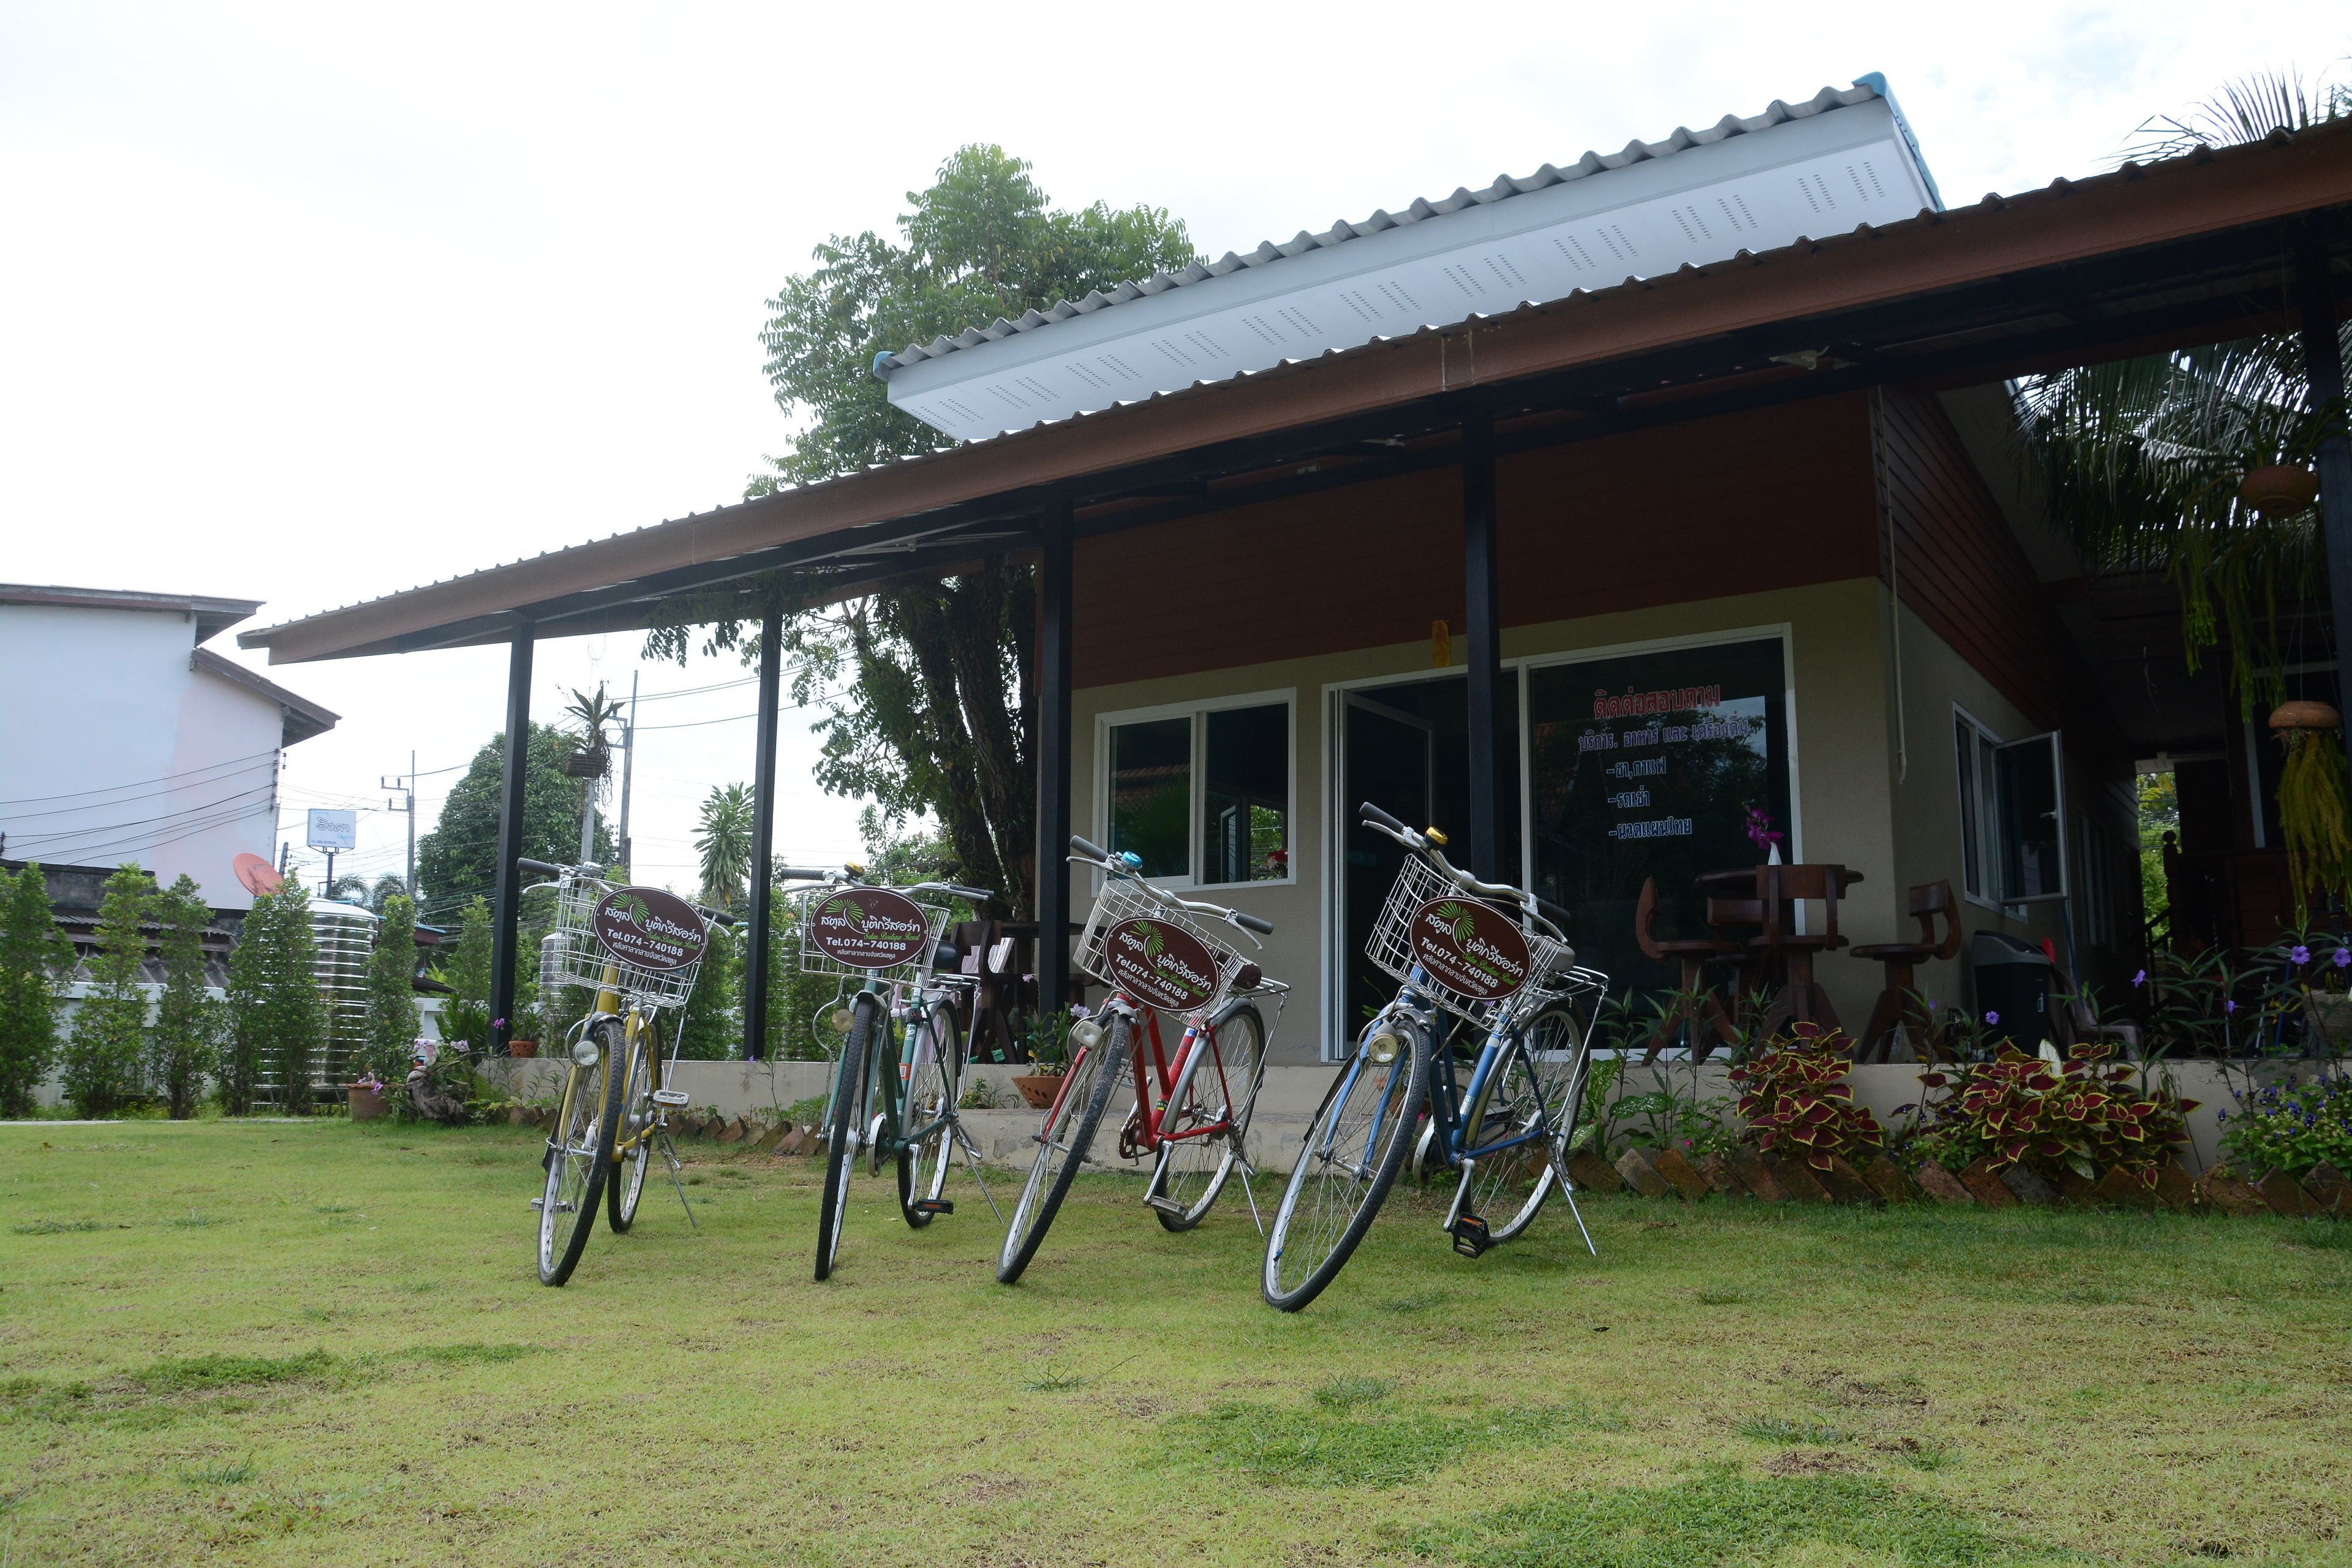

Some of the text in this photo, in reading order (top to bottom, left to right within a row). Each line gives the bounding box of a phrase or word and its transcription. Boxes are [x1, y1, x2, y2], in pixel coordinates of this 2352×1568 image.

[1594, 685, 1721, 720] ติดต่อสอบถาม
[1624, 728, 1659, 747] อาหาร
[1662, 725, 1688, 743] และ
[1692, 709, 1748, 740] เครื่องดื่ม
[605, 907, 701, 943] สตูล บูติกรีสอร์ท
[821, 914, 920, 933] สตูล บูติกรีสอร์ท
[1119, 932, 1212, 991] สตูล บูติกรีสอร์ท
[1425, 913, 1524, 978] สตูล บูติกรีสอร์ท
